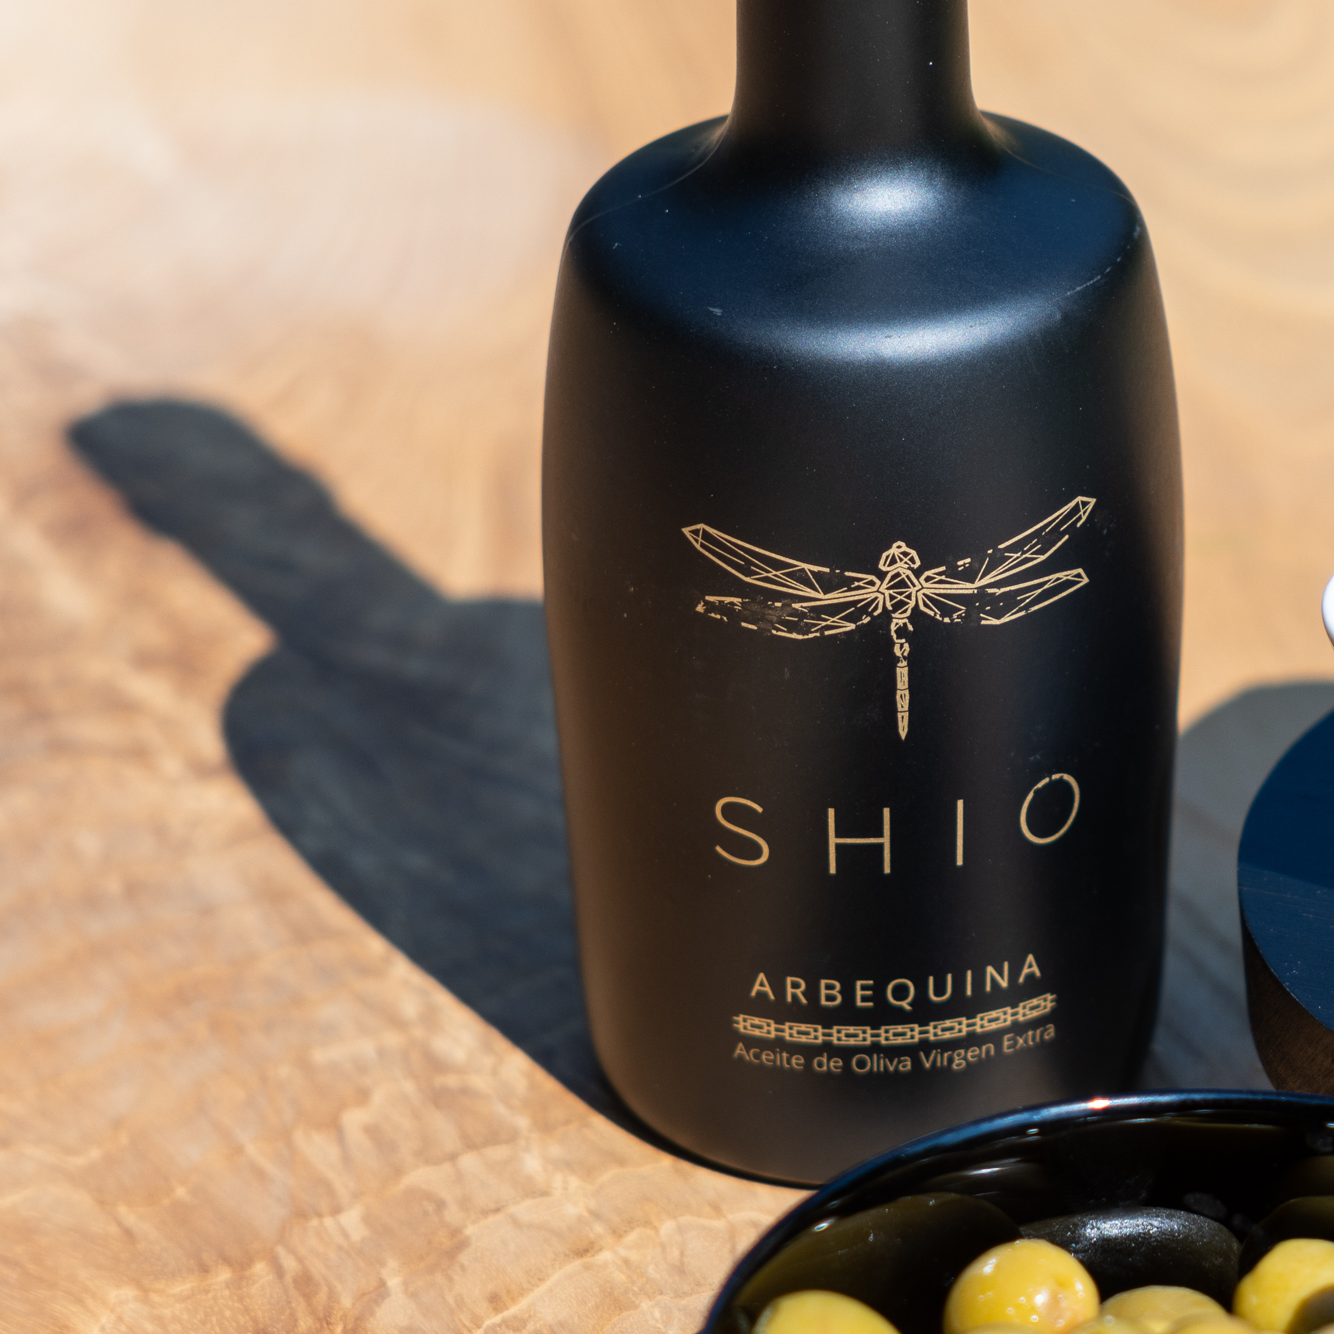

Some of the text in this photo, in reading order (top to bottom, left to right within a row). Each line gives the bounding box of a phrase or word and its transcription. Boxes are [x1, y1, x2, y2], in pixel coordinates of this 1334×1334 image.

[714, 772, 1081, 875] SHIO
[750, 953, 1042, 1011] ARBEQUINA
[733, 1023, 1056, 1074] Aceite de Oliva Virgen Extra
